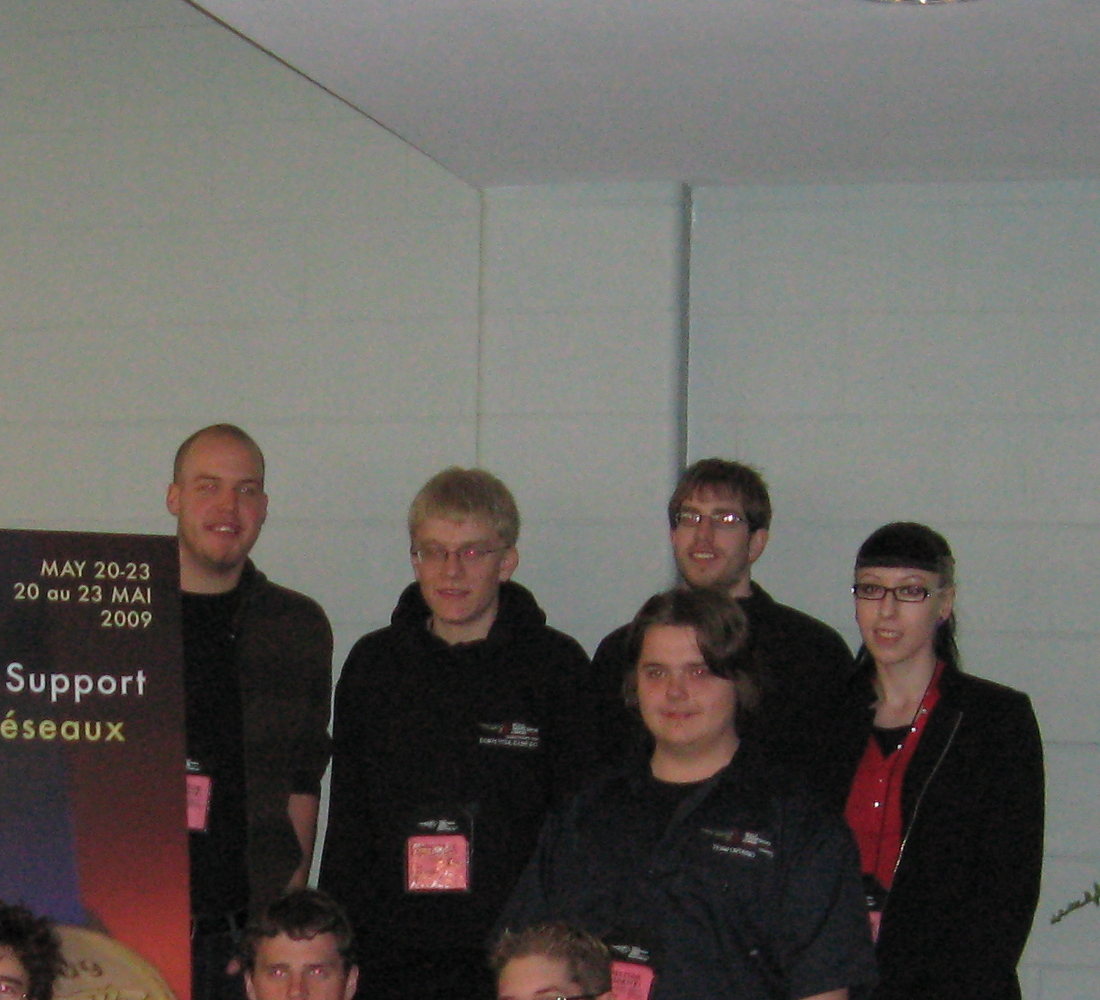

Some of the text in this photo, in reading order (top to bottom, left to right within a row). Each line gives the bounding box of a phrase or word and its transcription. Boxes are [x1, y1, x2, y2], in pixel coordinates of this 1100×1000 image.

[40, 559, 150, 580] MAY 20-23
[13, 582, 151, 604] 20 au 23 MAI
[100, 609, 152, 628] 2009
[6, 662, 147, 703] Support
